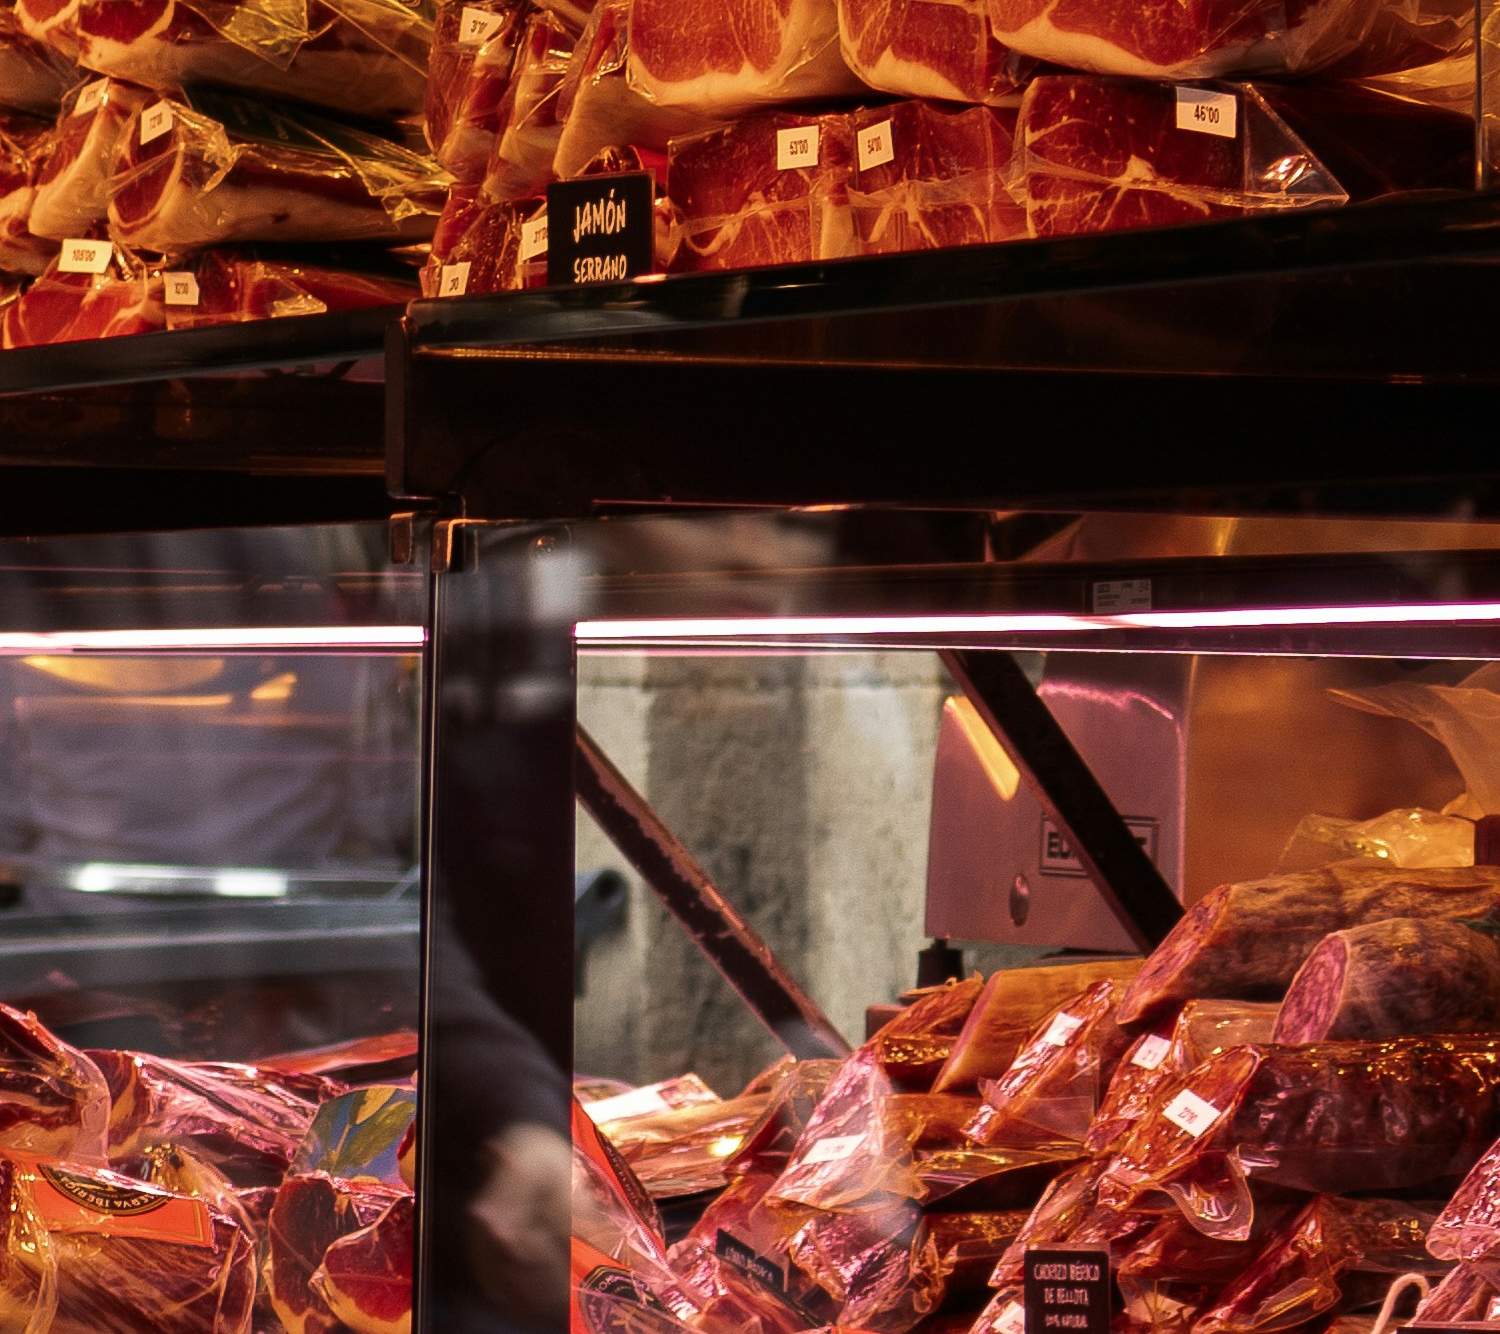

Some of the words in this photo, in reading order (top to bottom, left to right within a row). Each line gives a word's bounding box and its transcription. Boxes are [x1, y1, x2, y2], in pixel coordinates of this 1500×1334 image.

[1193, 103, 1220, 125] 46'00
[572, 188, 628, 245] JAMÓN
[573, 253, 628, 284] SERRANO
[1043, 1287, 1058, 1304] DE
